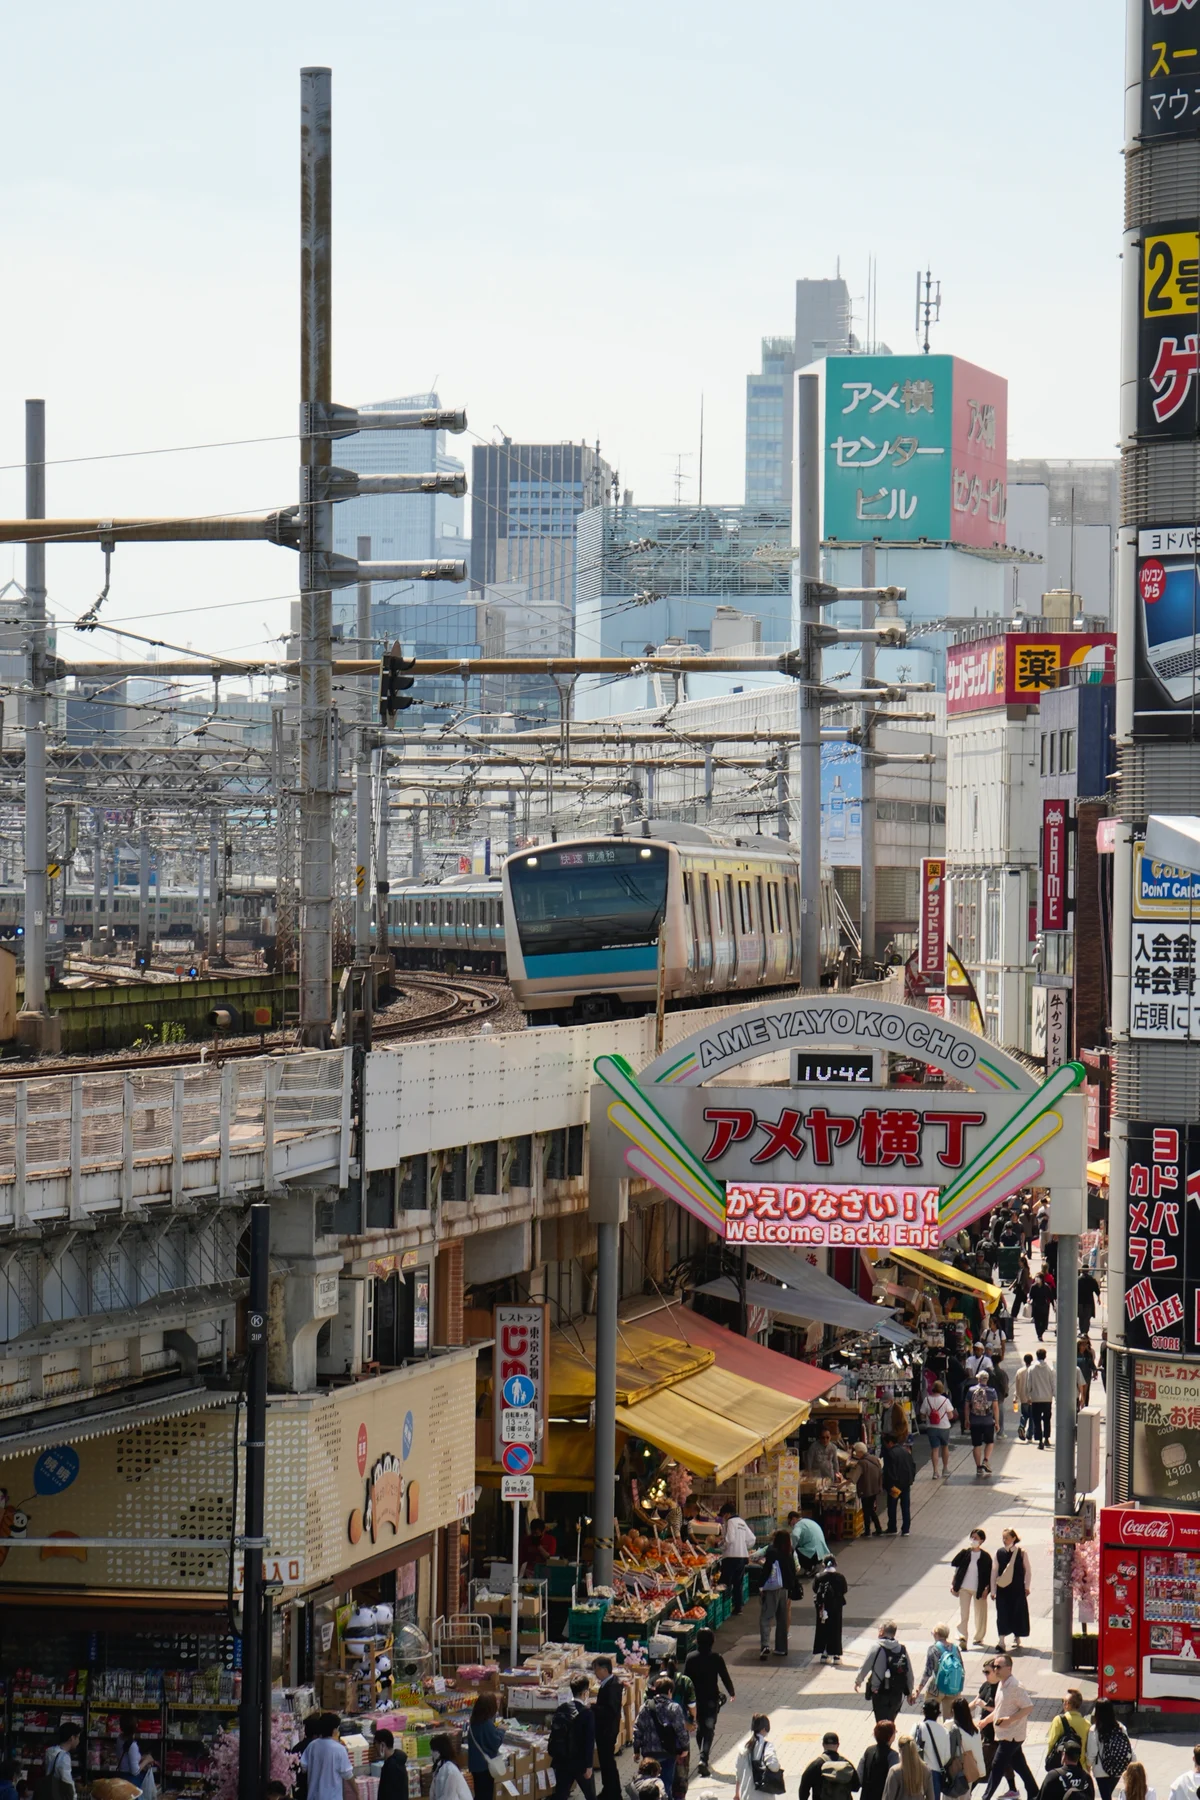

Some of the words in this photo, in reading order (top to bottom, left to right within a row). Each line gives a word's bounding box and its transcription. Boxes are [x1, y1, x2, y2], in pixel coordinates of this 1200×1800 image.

[841, 379, 934, 414] アメ横
[830, 435, 945, 467] センター
[856, 487, 918, 520] ビル
[1144, 582, 1160, 599] から
[948, 652, 988, 701] サンドラッグ
[1019, 649, 1056, 688] 薬
[560, 852, 584, 865] 快速
[1047, 831, 1060, 921] GAME
[927, 894, 940, 970] サンドラッグ
[1134, 933, 1197, 963] 入会金
[1134, 965, 1197, 996] 年会費
[700, 1008, 977, 1069] AMEYAYOKOCHO
[702, 1106, 987, 1168] アメヤ横丁
[1128, 1163, 1149, 1270] カメラ
[1151, 1128, 1179, 1272] ヨドバシ
[726, 1220, 825, 1245] Welcome
[828, 1223, 890, 1246] Back!
[1125, 1277, 1158, 1321] TAX
[1143, 1293, 1184, 1337] FREE
[500, 1312, 541, 1322] レストラン
[529, 1326, 539, 1380] 東京名物
[1152, 1336, 1180, 1350] STORE
[1158, 1384, 1182, 1396] GOLD
[1165, 1463, 1192, 1479] 4980
[1122, 1519, 1170, 1538] Coca-Cola
